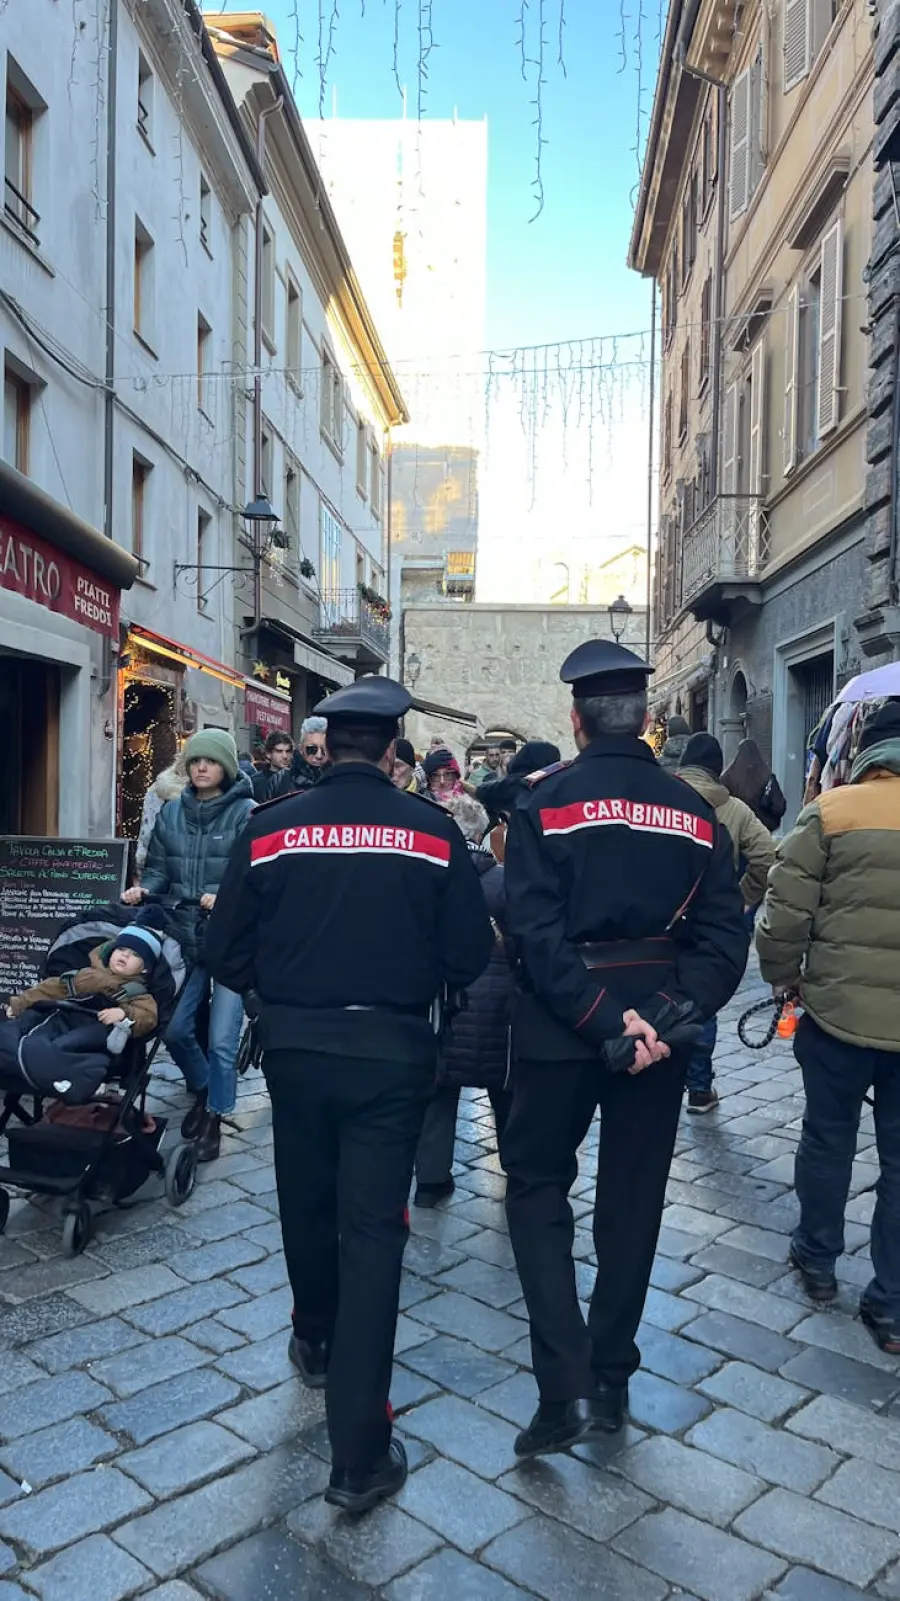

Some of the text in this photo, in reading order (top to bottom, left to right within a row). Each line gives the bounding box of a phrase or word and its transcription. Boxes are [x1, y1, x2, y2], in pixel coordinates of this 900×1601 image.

[0, 531, 60, 600] ATRO
[77, 576, 110, 608] PIATTI
[74, 595, 112, 627] FREDDI
[583, 800, 698, 835] CARABINIERI
[284, 827, 414, 850] CARABINIERI
[70, 869, 118, 881] SUPERIORE
